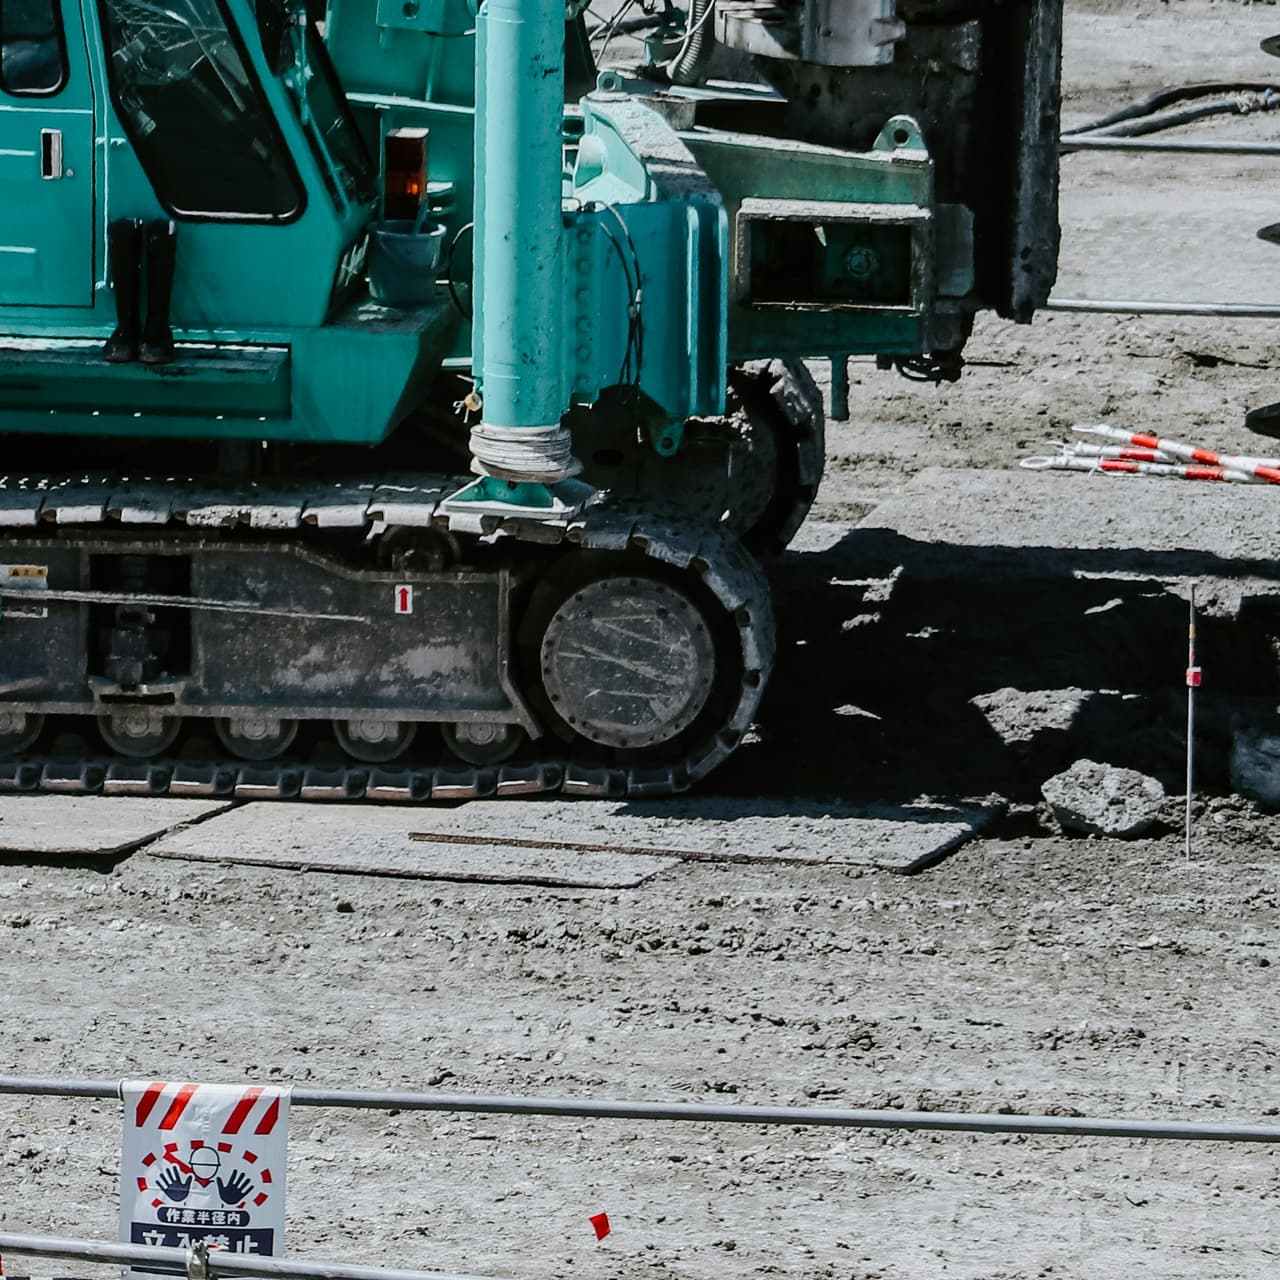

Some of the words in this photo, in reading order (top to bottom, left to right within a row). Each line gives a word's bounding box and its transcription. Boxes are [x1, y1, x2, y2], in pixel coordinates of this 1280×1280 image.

[166, 1208, 242, 1226] 作業半径内
